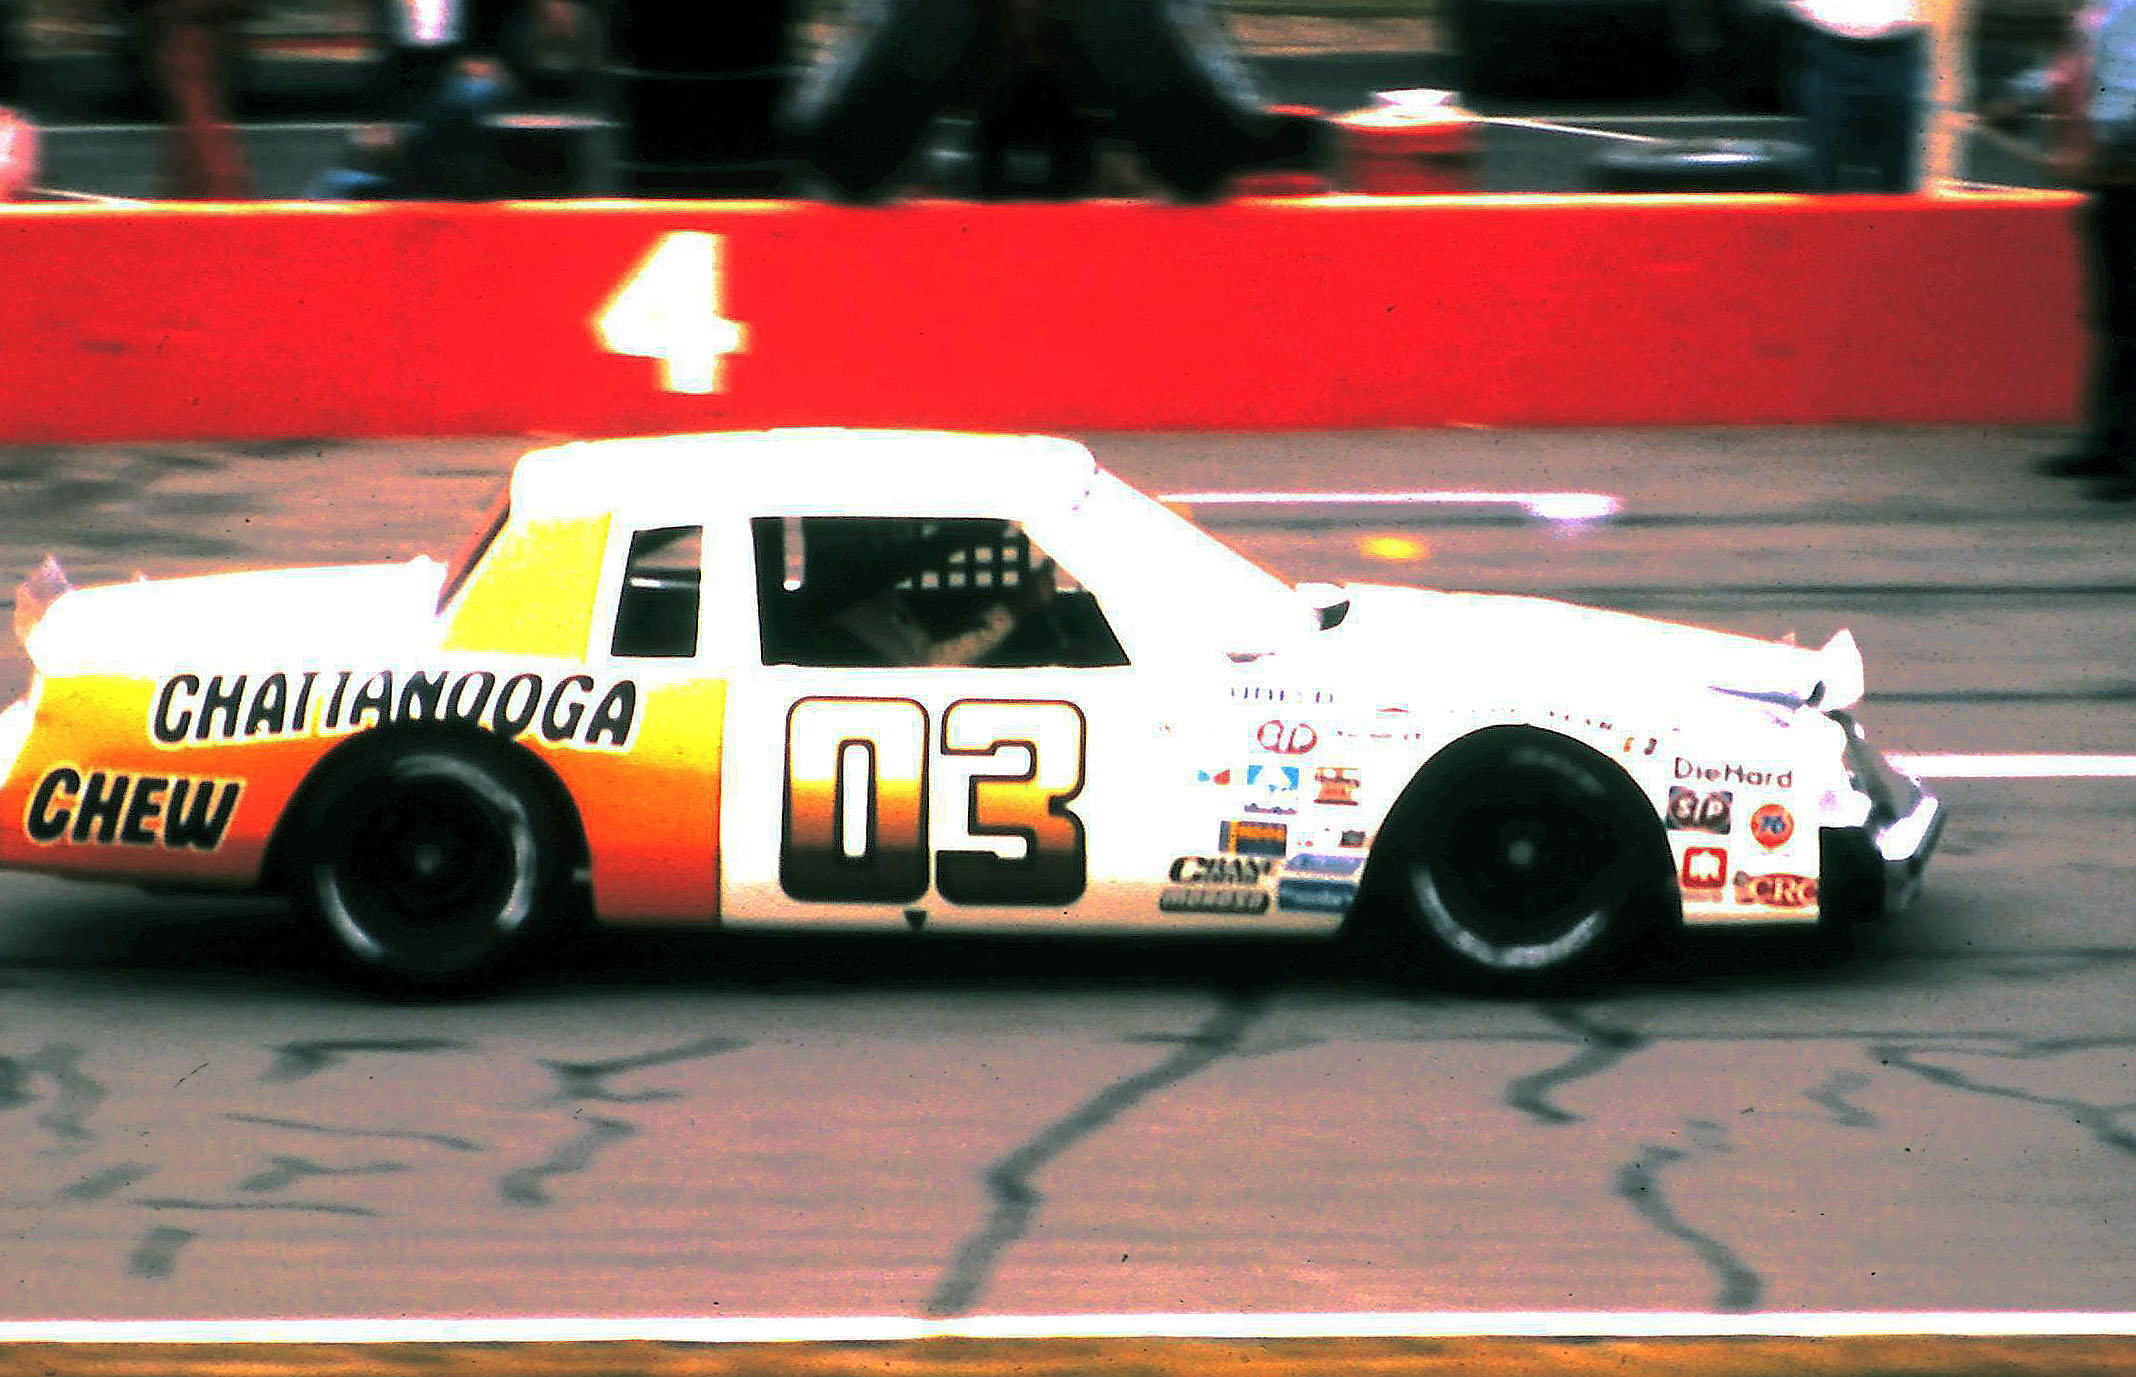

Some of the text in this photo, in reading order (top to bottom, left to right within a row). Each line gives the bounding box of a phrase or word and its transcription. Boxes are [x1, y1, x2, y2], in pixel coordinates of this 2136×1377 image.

[590, 231, 746, 393] 4
[26, 767, 241, 850] CHEW
[779, 696, 1087, 907] 03
[1674, 756, 1793, 788] DieHard
